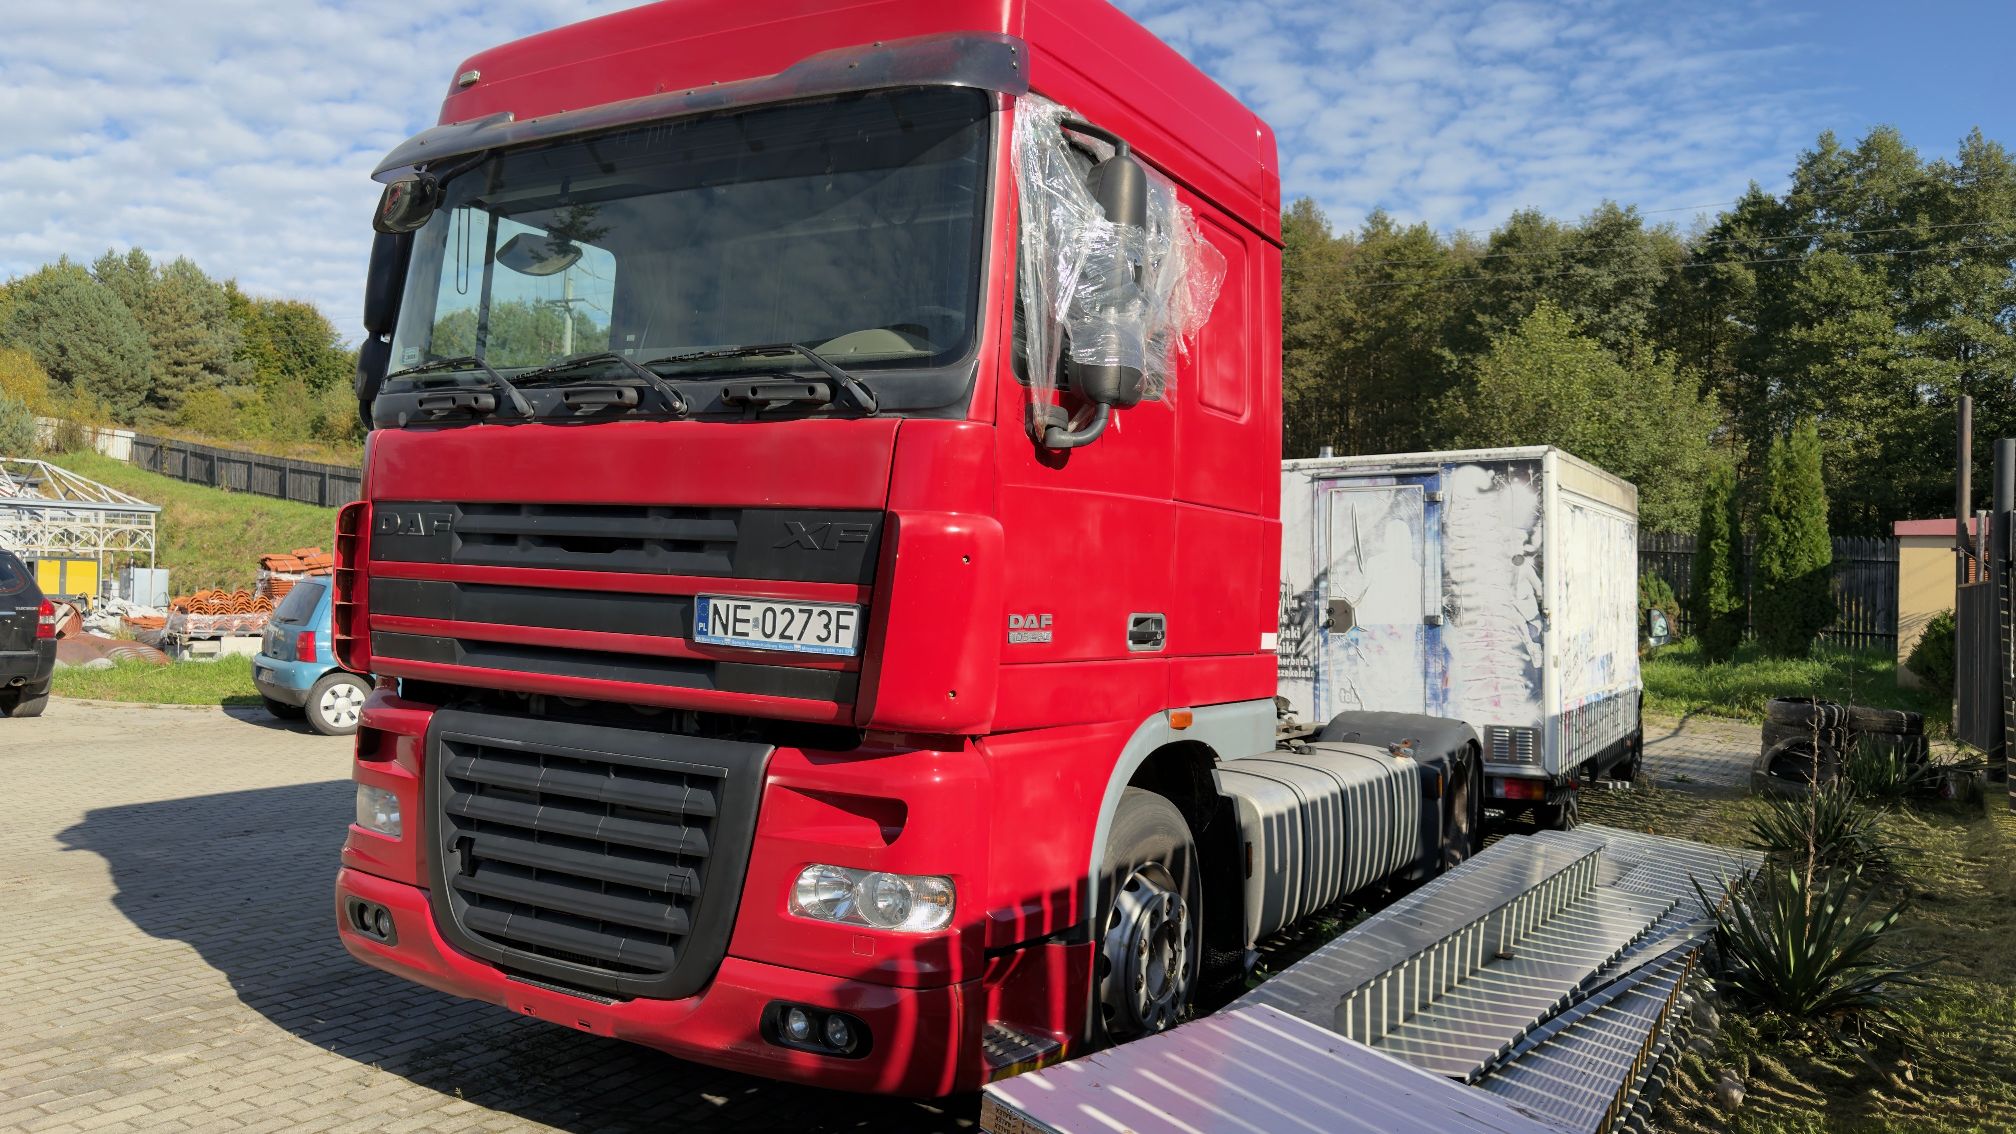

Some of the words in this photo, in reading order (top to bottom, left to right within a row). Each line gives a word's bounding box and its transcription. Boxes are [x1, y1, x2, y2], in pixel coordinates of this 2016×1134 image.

[376, 512, 453, 536] DAF
[772, 521, 873, 550] XF
[698, 622, 708, 632] PL
[711, 603, 752, 637] NE
[761, 606, 854, 643] 0273F
[1008, 614, 1053, 629] DAF
